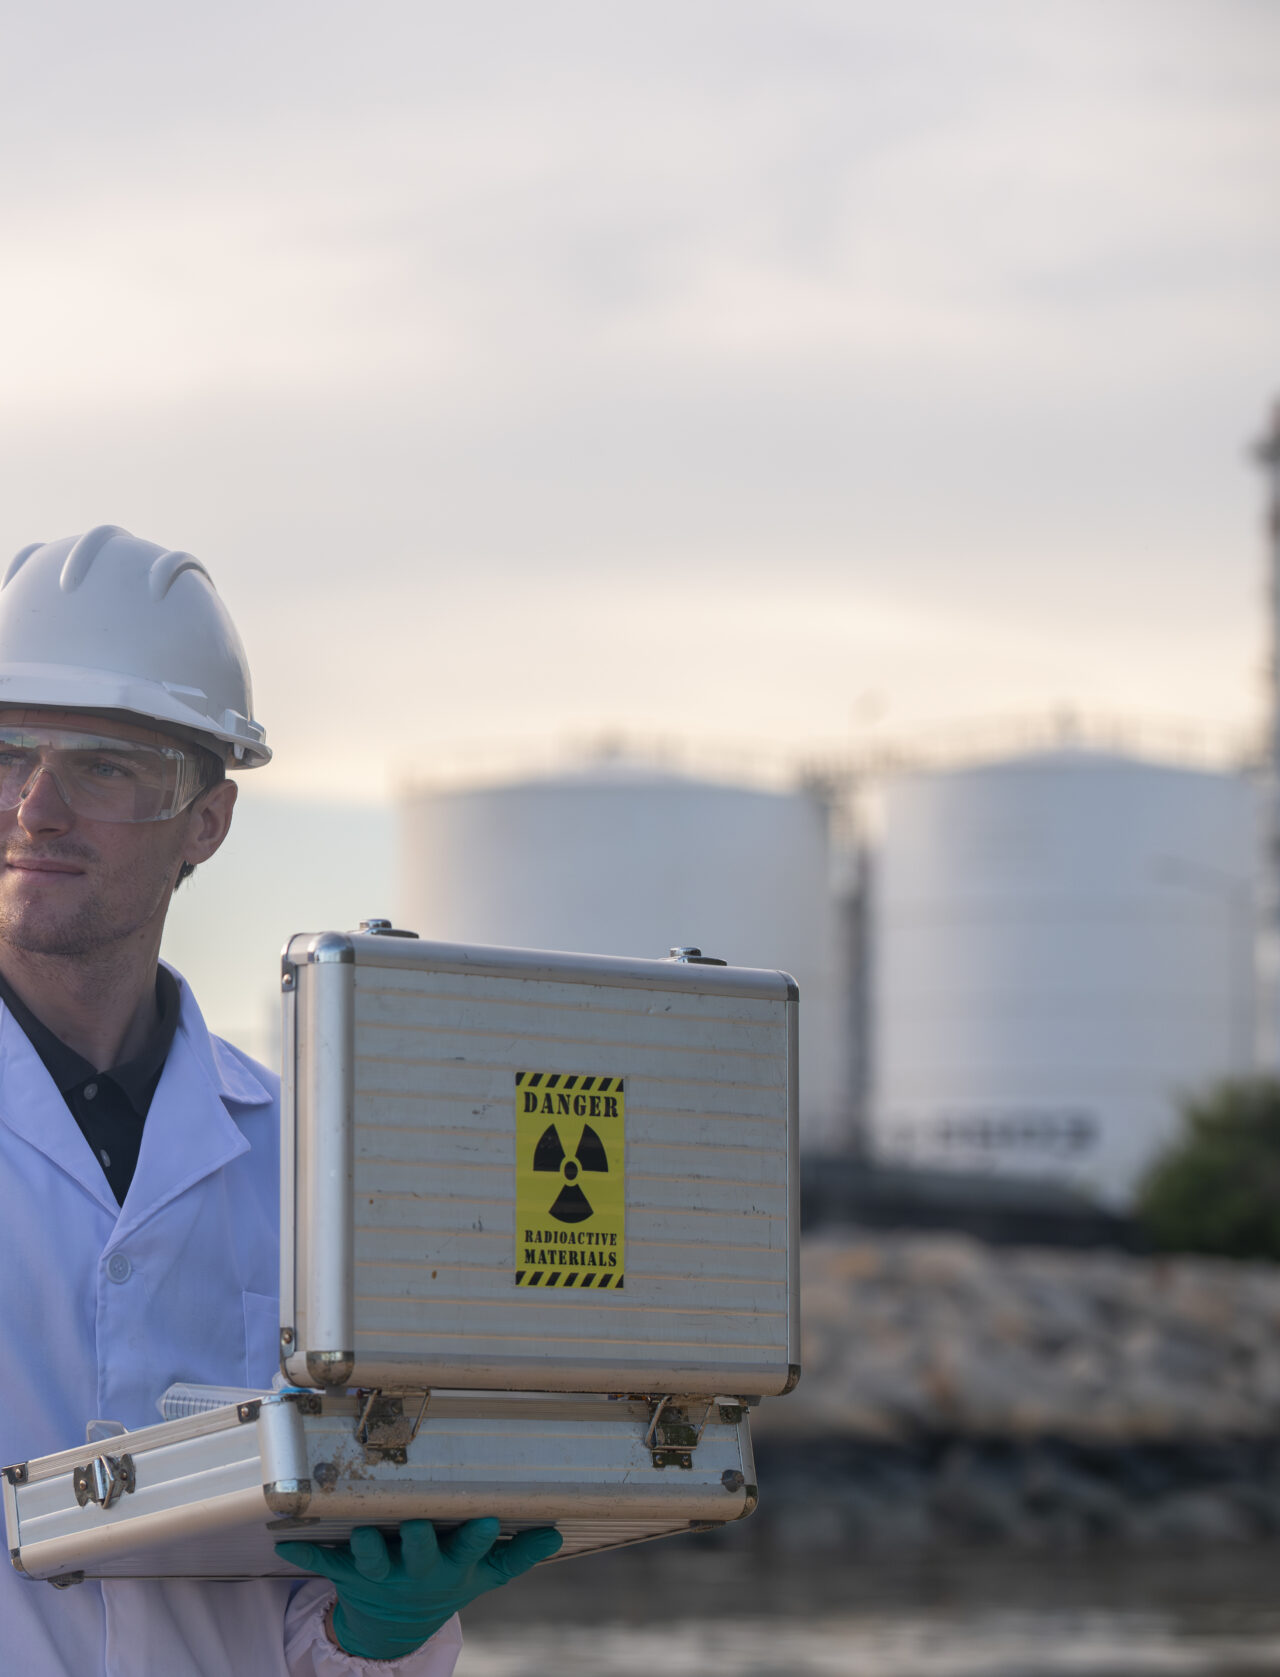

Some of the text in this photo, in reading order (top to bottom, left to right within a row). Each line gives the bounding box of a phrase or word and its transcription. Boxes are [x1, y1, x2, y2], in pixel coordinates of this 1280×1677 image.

[523, 1091, 619, 1118] DANGER
[524, 1229, 618, 1246] RADIOACTIVE
[524, 1248, 617, 1267] MATERIALS
